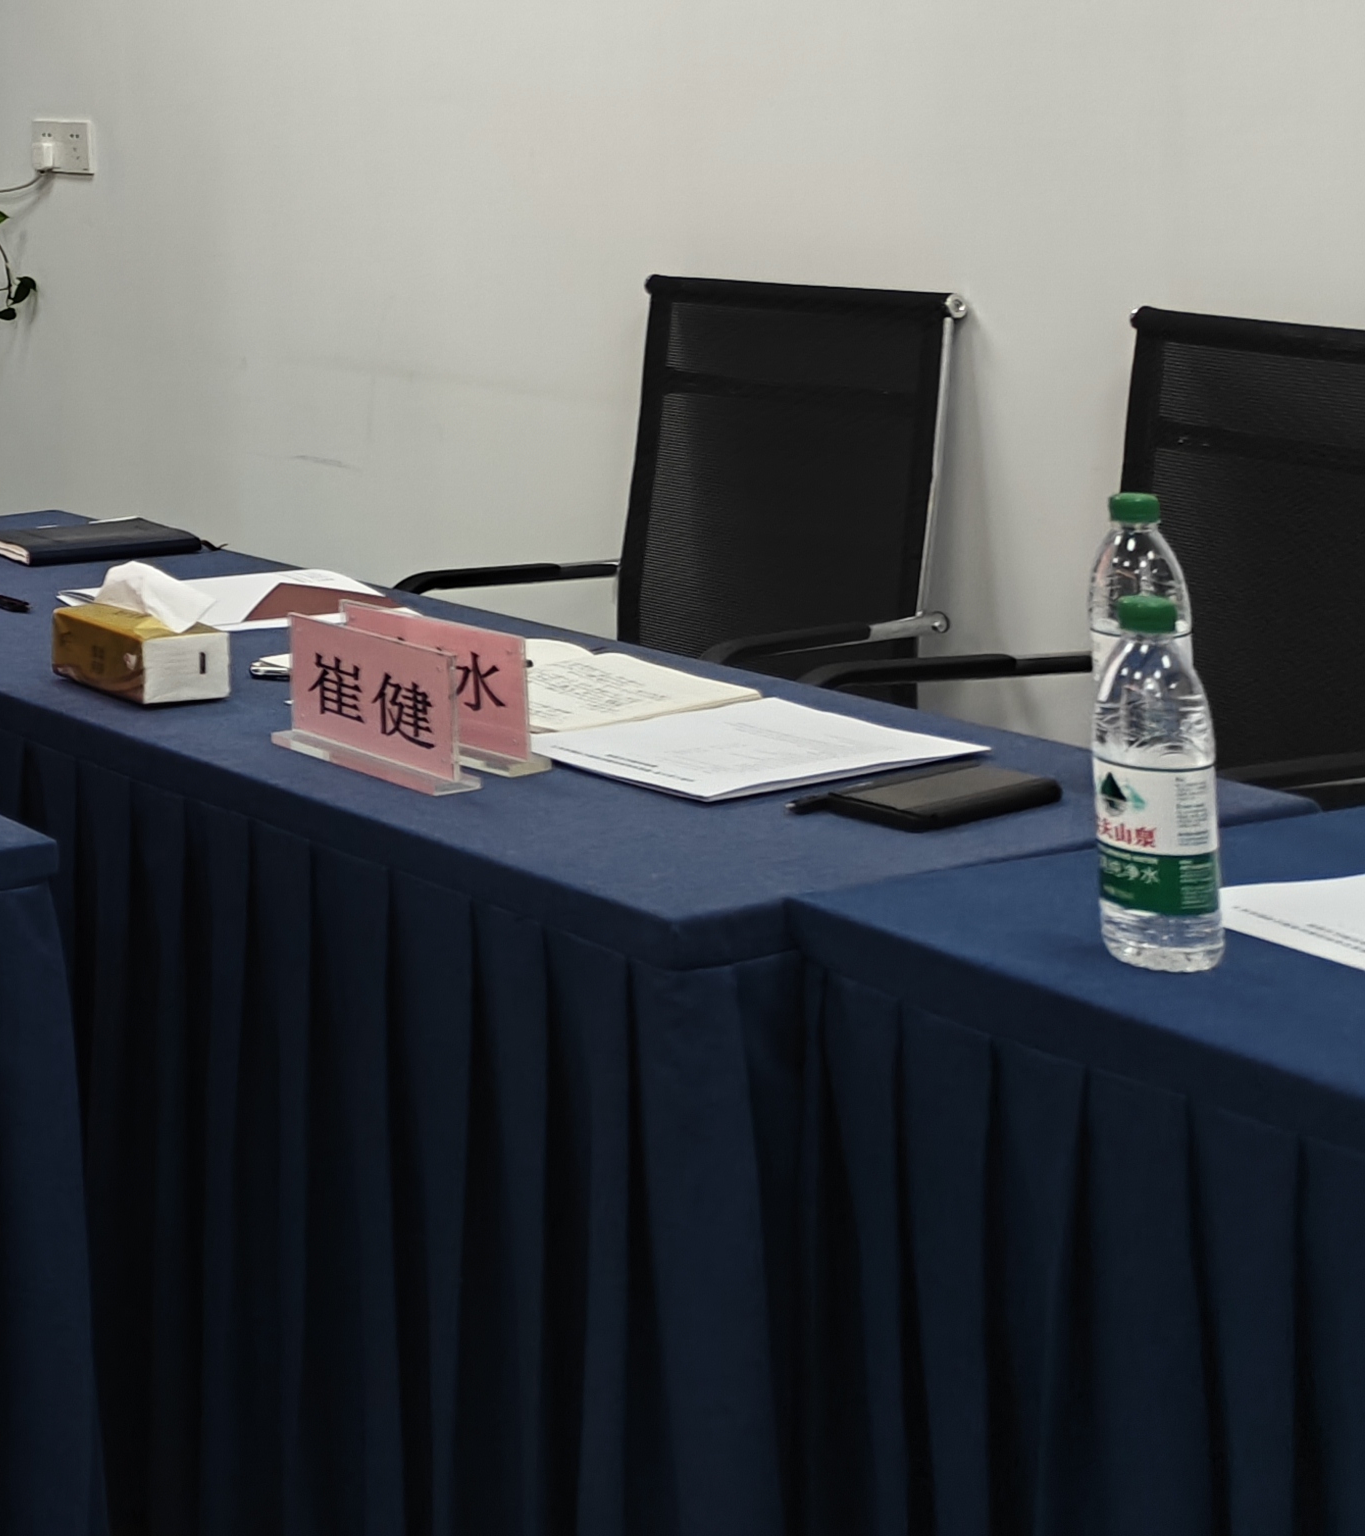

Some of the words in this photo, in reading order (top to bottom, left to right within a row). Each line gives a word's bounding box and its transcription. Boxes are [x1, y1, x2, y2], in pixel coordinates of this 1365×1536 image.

[307, 651, 437, 750] 崔健
[1097, 817, 1157, 849] 夫山泉
